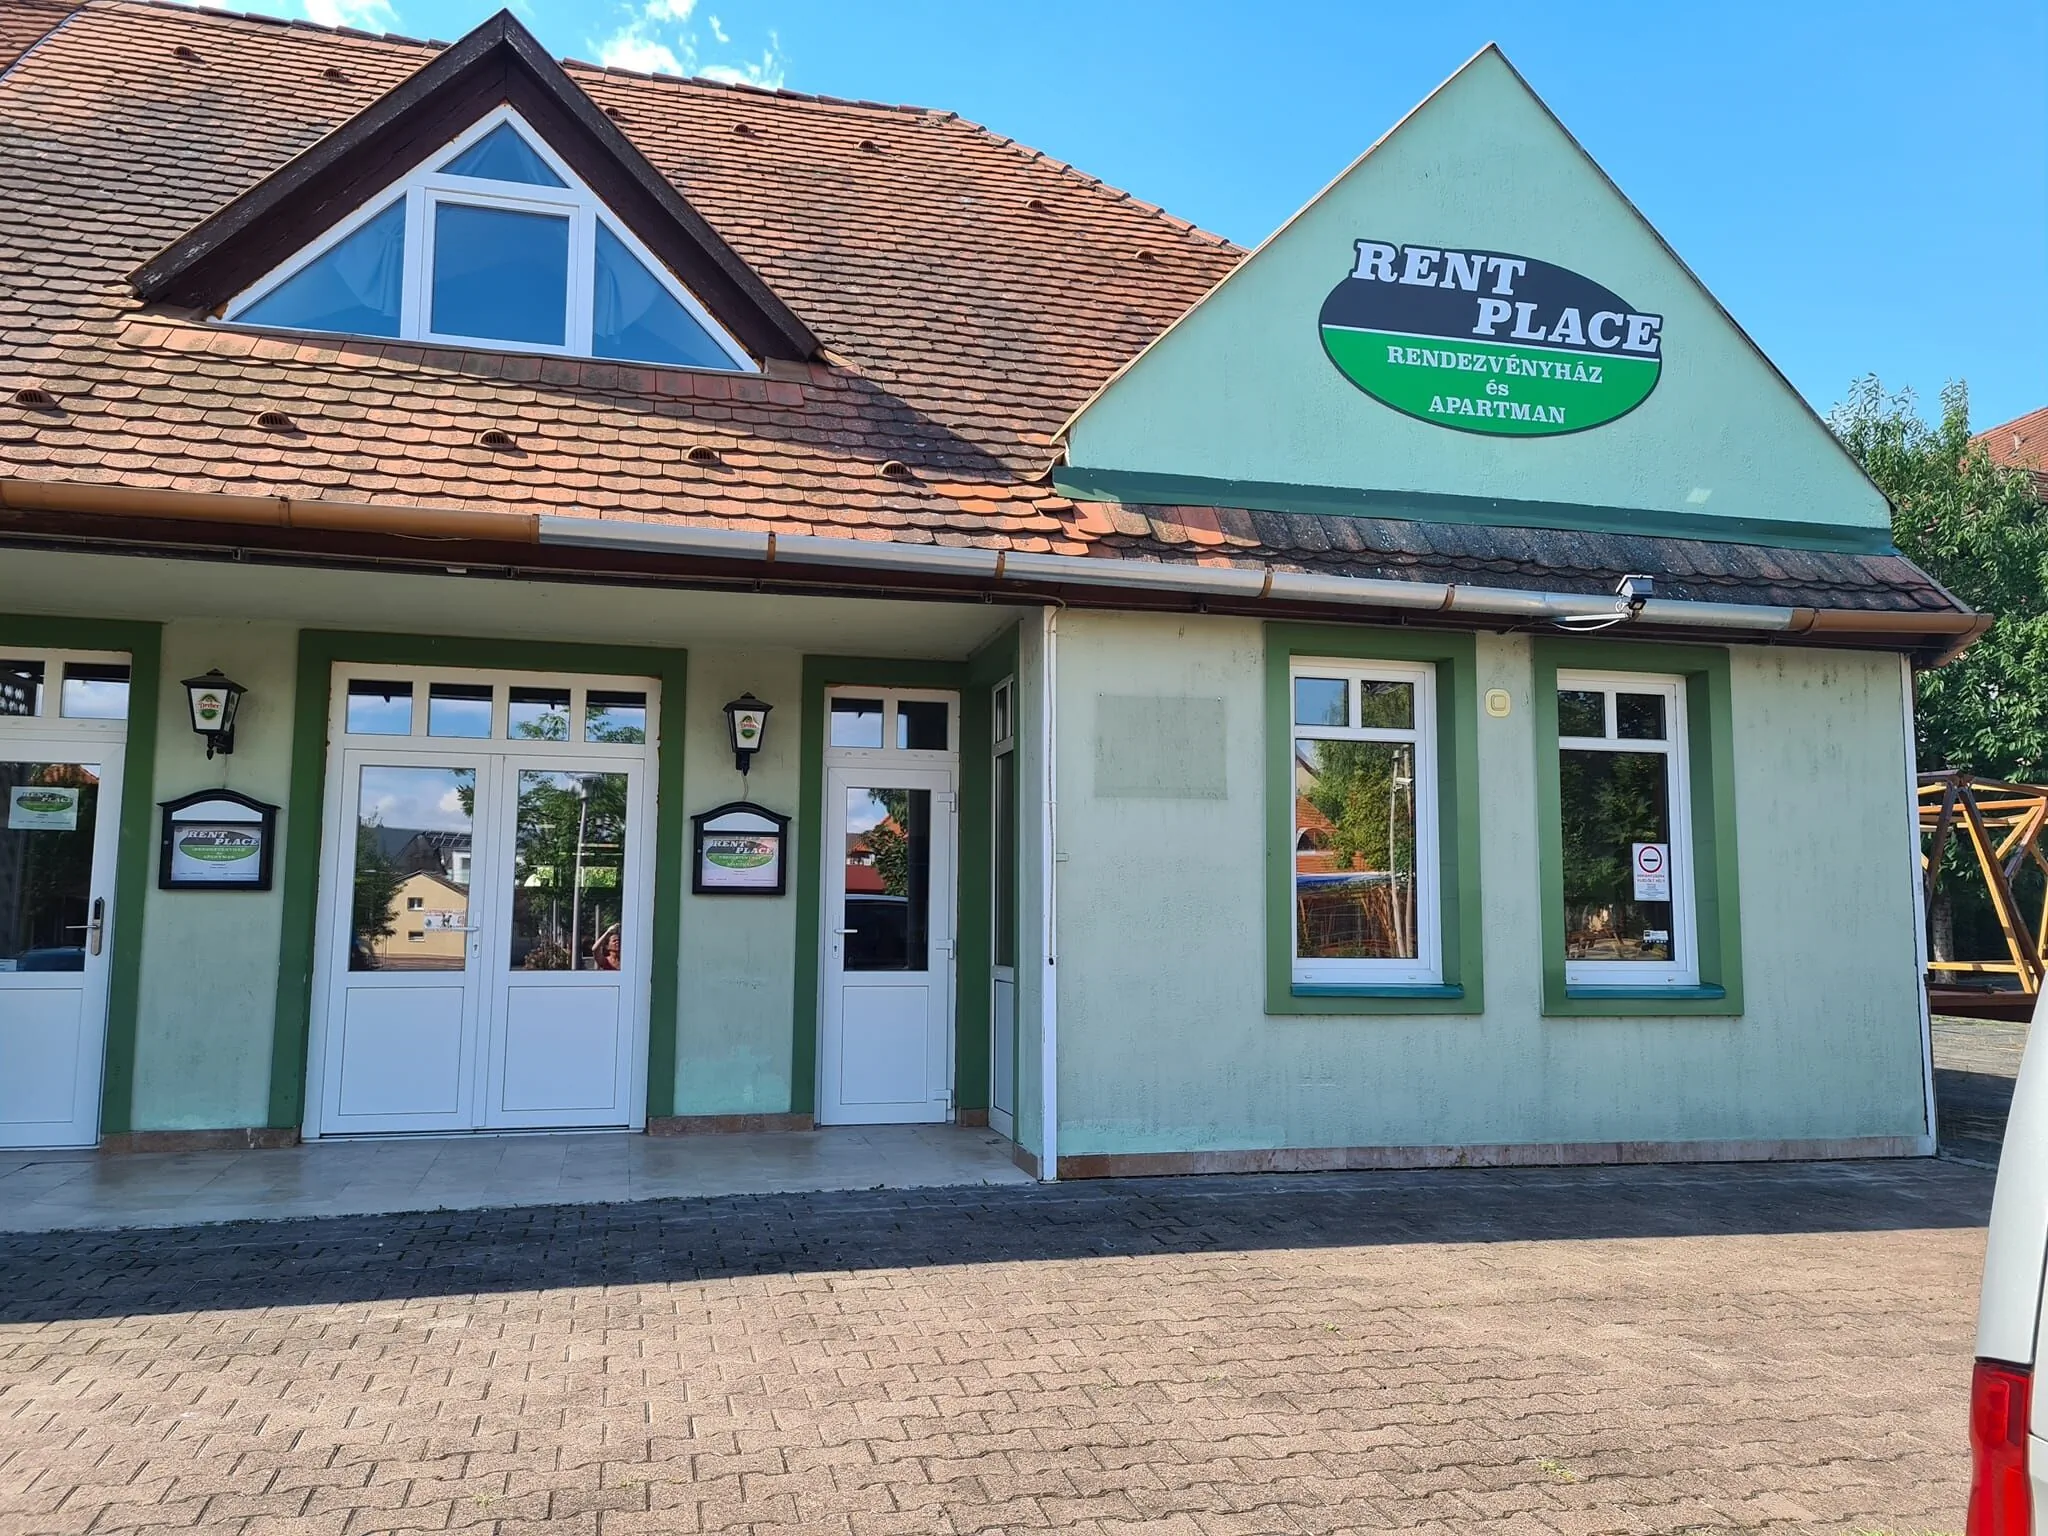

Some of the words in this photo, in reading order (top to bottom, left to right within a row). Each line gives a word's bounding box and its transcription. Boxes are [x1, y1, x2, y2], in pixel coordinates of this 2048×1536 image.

[1352, 241, 1526, 295] RENT
[1472, 297, 1662, 353] PLACE
[1387, 345, 1603, 384] RENDEZVÉNYHÁZ
[1485, 379, 1509, 396] és
[1428, 395, 1565, 424] APARTMAN
